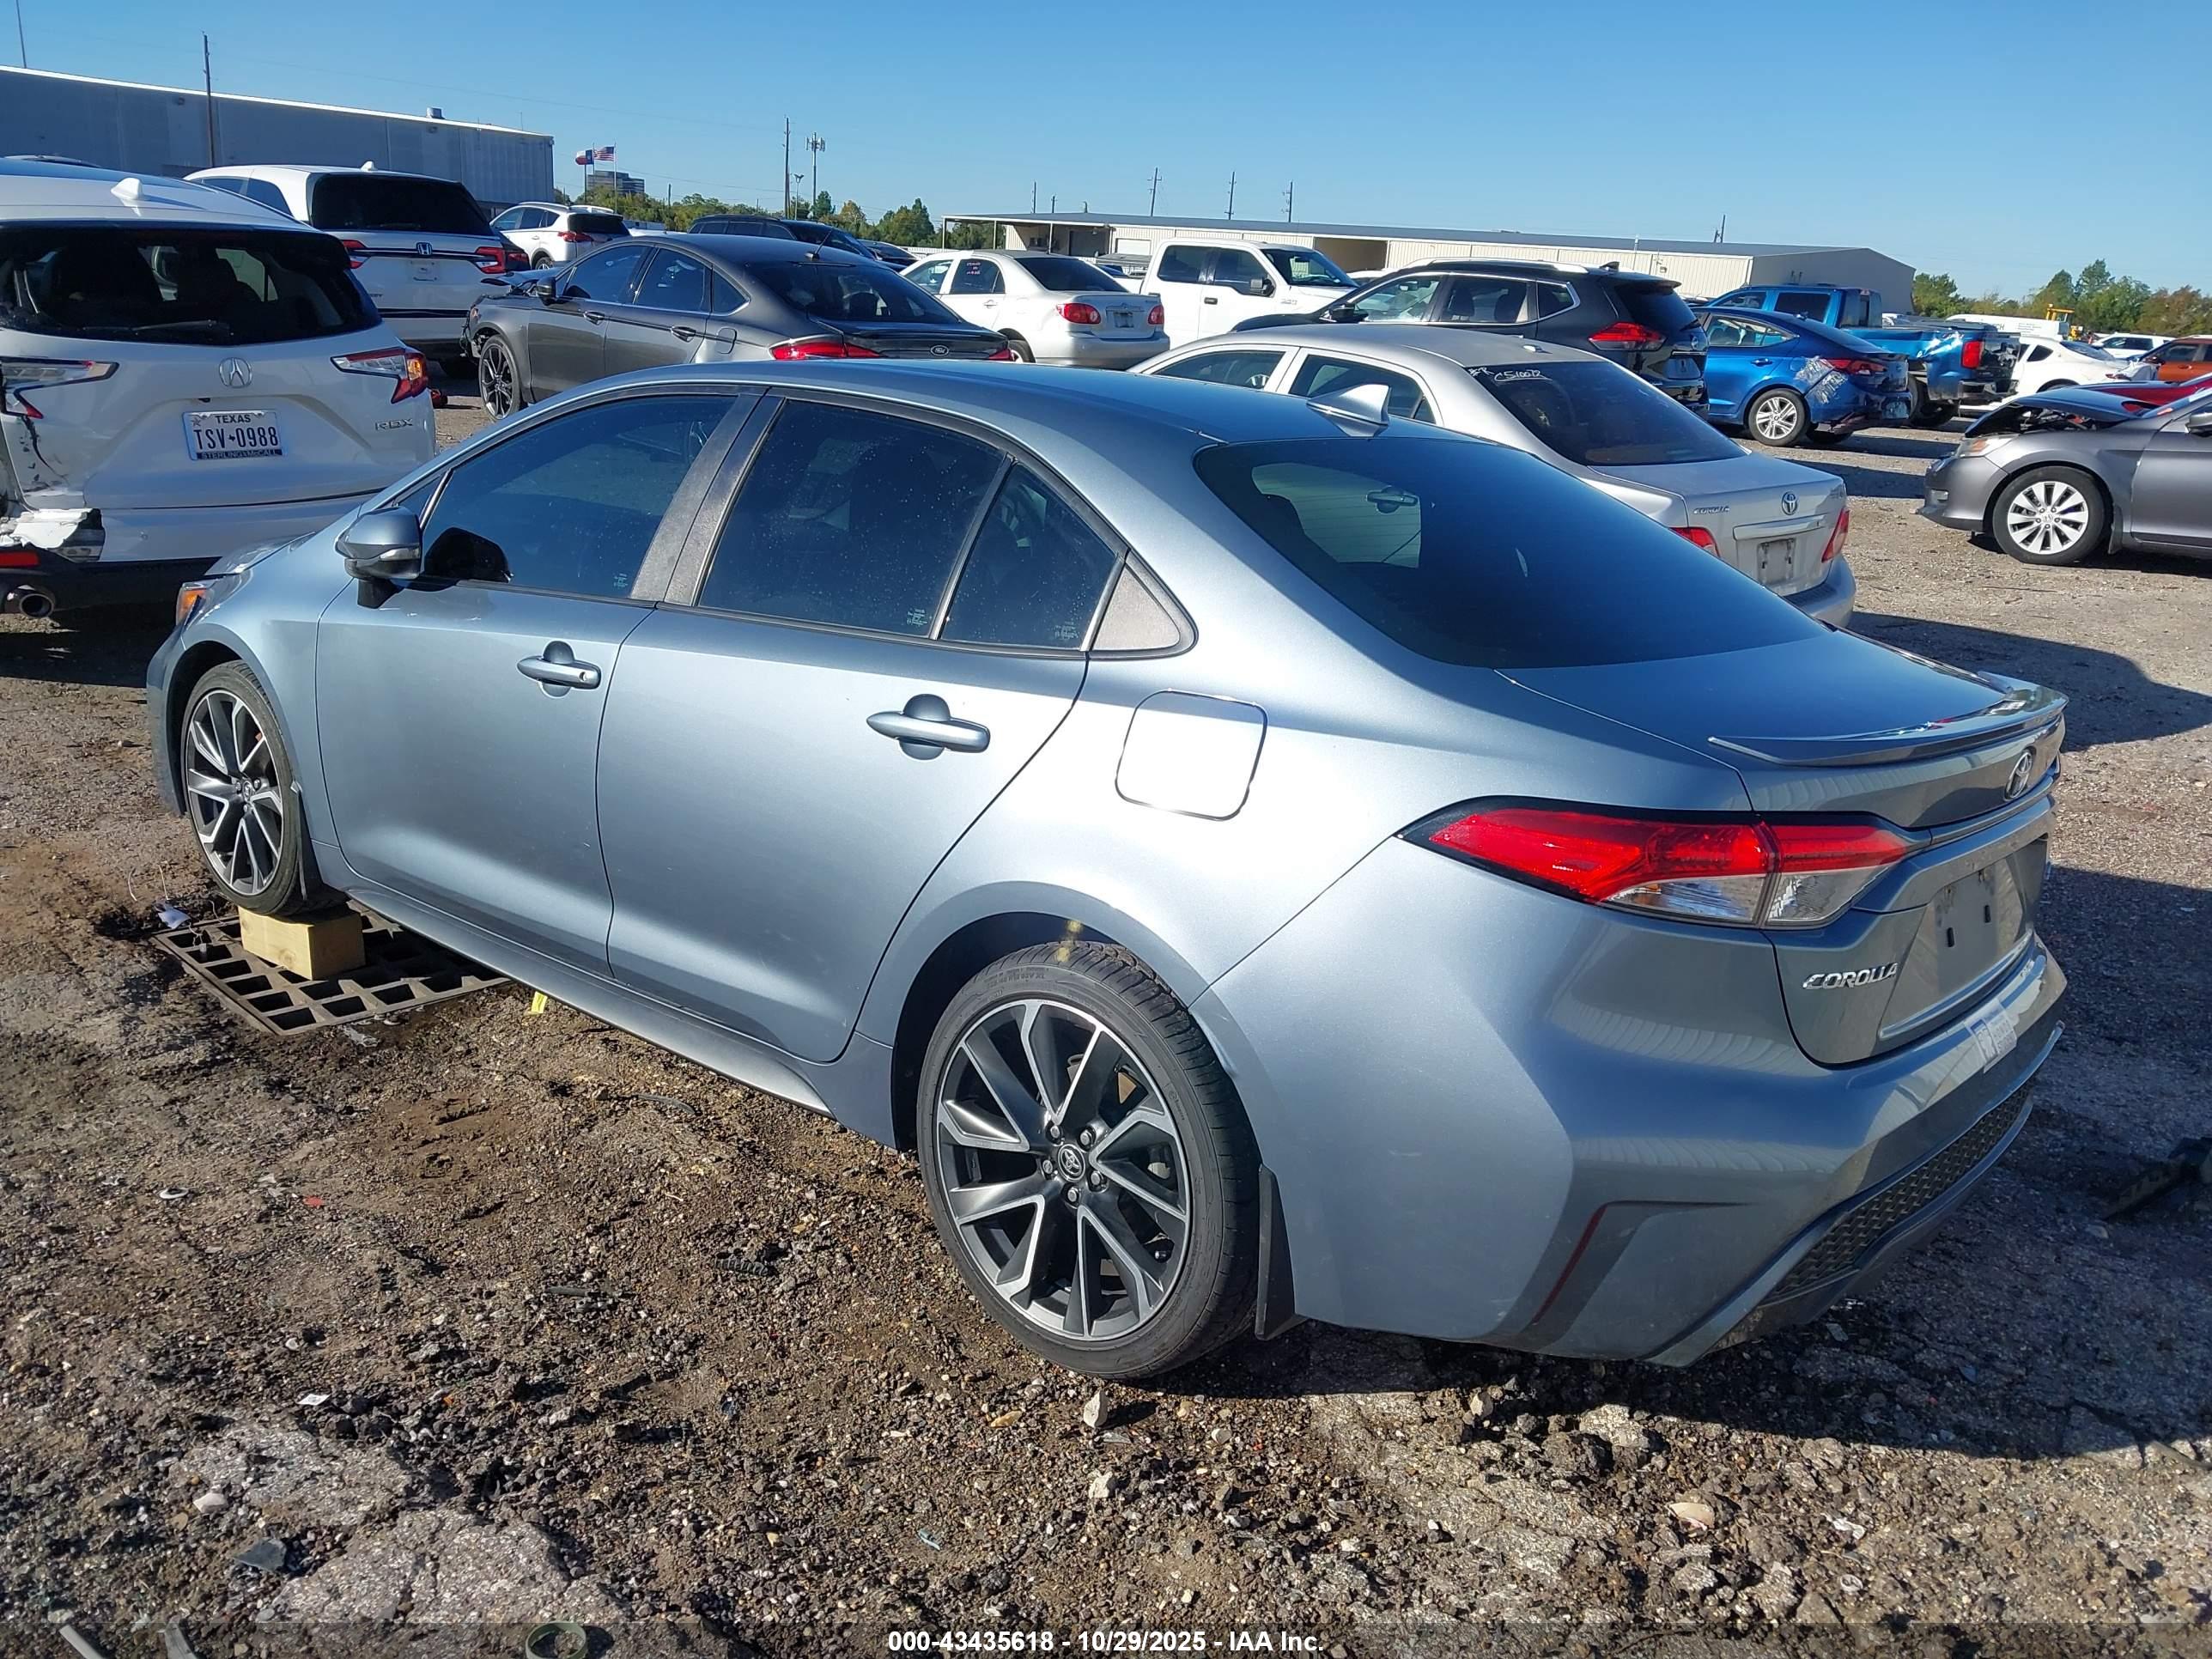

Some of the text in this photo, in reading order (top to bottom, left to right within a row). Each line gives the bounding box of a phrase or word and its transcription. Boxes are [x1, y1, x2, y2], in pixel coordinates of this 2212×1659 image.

[216, 414, 252, 424] TEXAS
[374, 418, 413, 430] RDX
[1802, 962, 1899, 990] COROLLA
